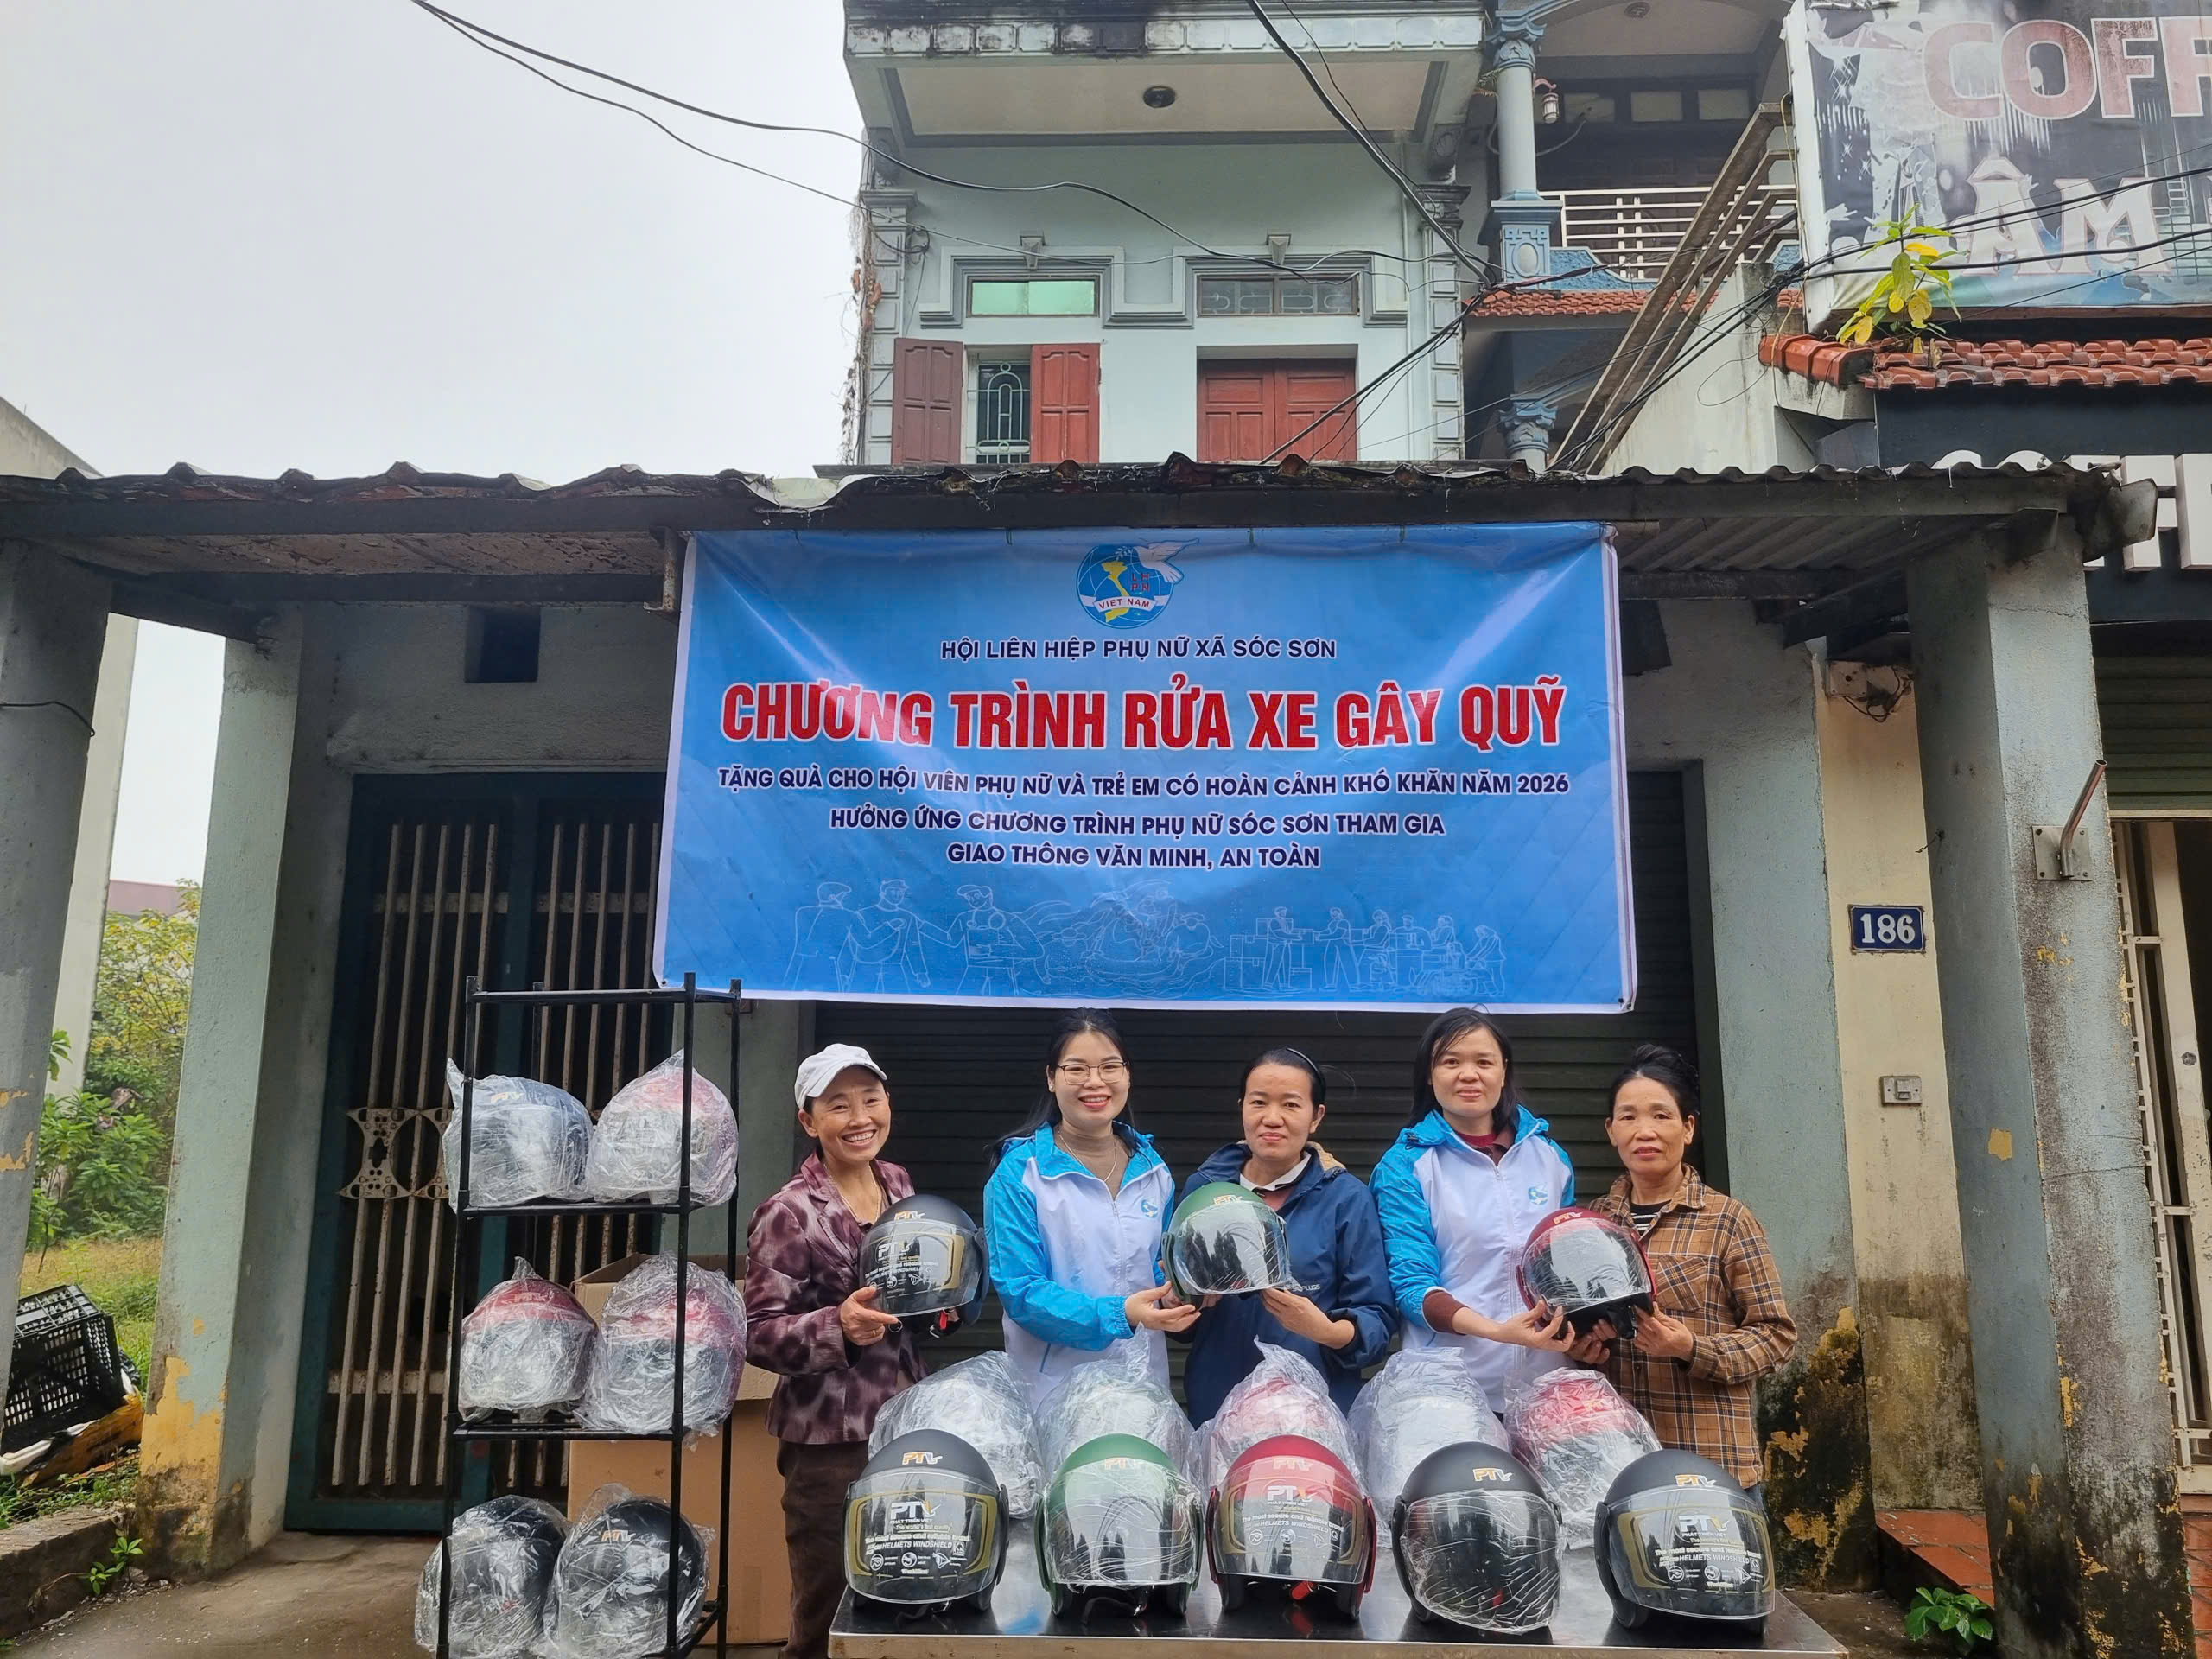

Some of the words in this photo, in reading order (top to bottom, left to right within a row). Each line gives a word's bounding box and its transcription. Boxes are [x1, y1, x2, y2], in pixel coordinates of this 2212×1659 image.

[1098, 598, 1123, 609] VIET
[1127, 598, 1150, 608] NAM
[941, 637, 979, 661] HỘI
[987, 637, 1036, 658] LIÊN
[1044, 636, 1096, 661] HIỆP
[1103, 640, 1149, 661] PHỤ
[1157, 636, 1190, 658] NỮ
[1195, 636, 1226, 657] XÃ
[1233, 635, 1281, 658] SÓC
[1287, 638, 1335, 658] SƠN
[721, 679, 933, 747] CHƯƠNG
[950, 679, 1106, 749] TRÌNH
[1123, 672, 1233, 749] RỬA
[1246, 691, 1318, 749] XE
[1334, 680, 1443, 747] GÂY
[1459, 675, 1567, 753] QUỸ
[719, 764, 773, 792] TẶNG
[779, 764, 823, 788] QUÀ
[829, 769, 874, 789] CHO
[880, 765, 916, 793] HỘI
[923, 769, 969, 792] VIÊN
[976, 776, 1016, 799] PHỤ
[1022, 772, 1052, 795] NỮ
[1057, 772, 1086, 796] VÀ
[1092, 771, 1125, 796] TRẺ
[1132, 778, 1160, 796] EM
[1166, 772, 1199, 796] CÓ
[1206, 772, 1268, 796] HOÀN
[1274, 771, 1337, 795] CẢNH
[1344, 769, 1390, 793] KHÓ
[1397, 769, 1455, 793] KHĂN
[1462, 770, 1510, 793] NĂM
[1517, 774, 1569, 793] 2026
[830, 804, 907, 829] HƯỞNG
[913, 804, 962, 829] ỨNG
[968, 811, 1067, 834] CHƯƠNG
[1073, 810, 1135, 836] TRÌNH
[1141, 817, 1185, 840] PHỤ
[1192, 812, 1223, 835] NỮ
[1229, 812, 1276, 835] SÓC
[1282, 812, 1329, 834] SƠN
[1335, 815, 1398, 835] THAM
[1404, 815, 1446, 835] GIA
[948, 843, 1005, 864] GIAO
[1011, 842, 1089, 866] THÔNG
[1096, 843, 1142, 867] VĂN
[1149, 848, 1214, 869] MINH,
[1220, 849, 1253, 867] AN
[1258, 842, 1320, 868] TOÀN
[1859, 913, 1916, 944] 186
